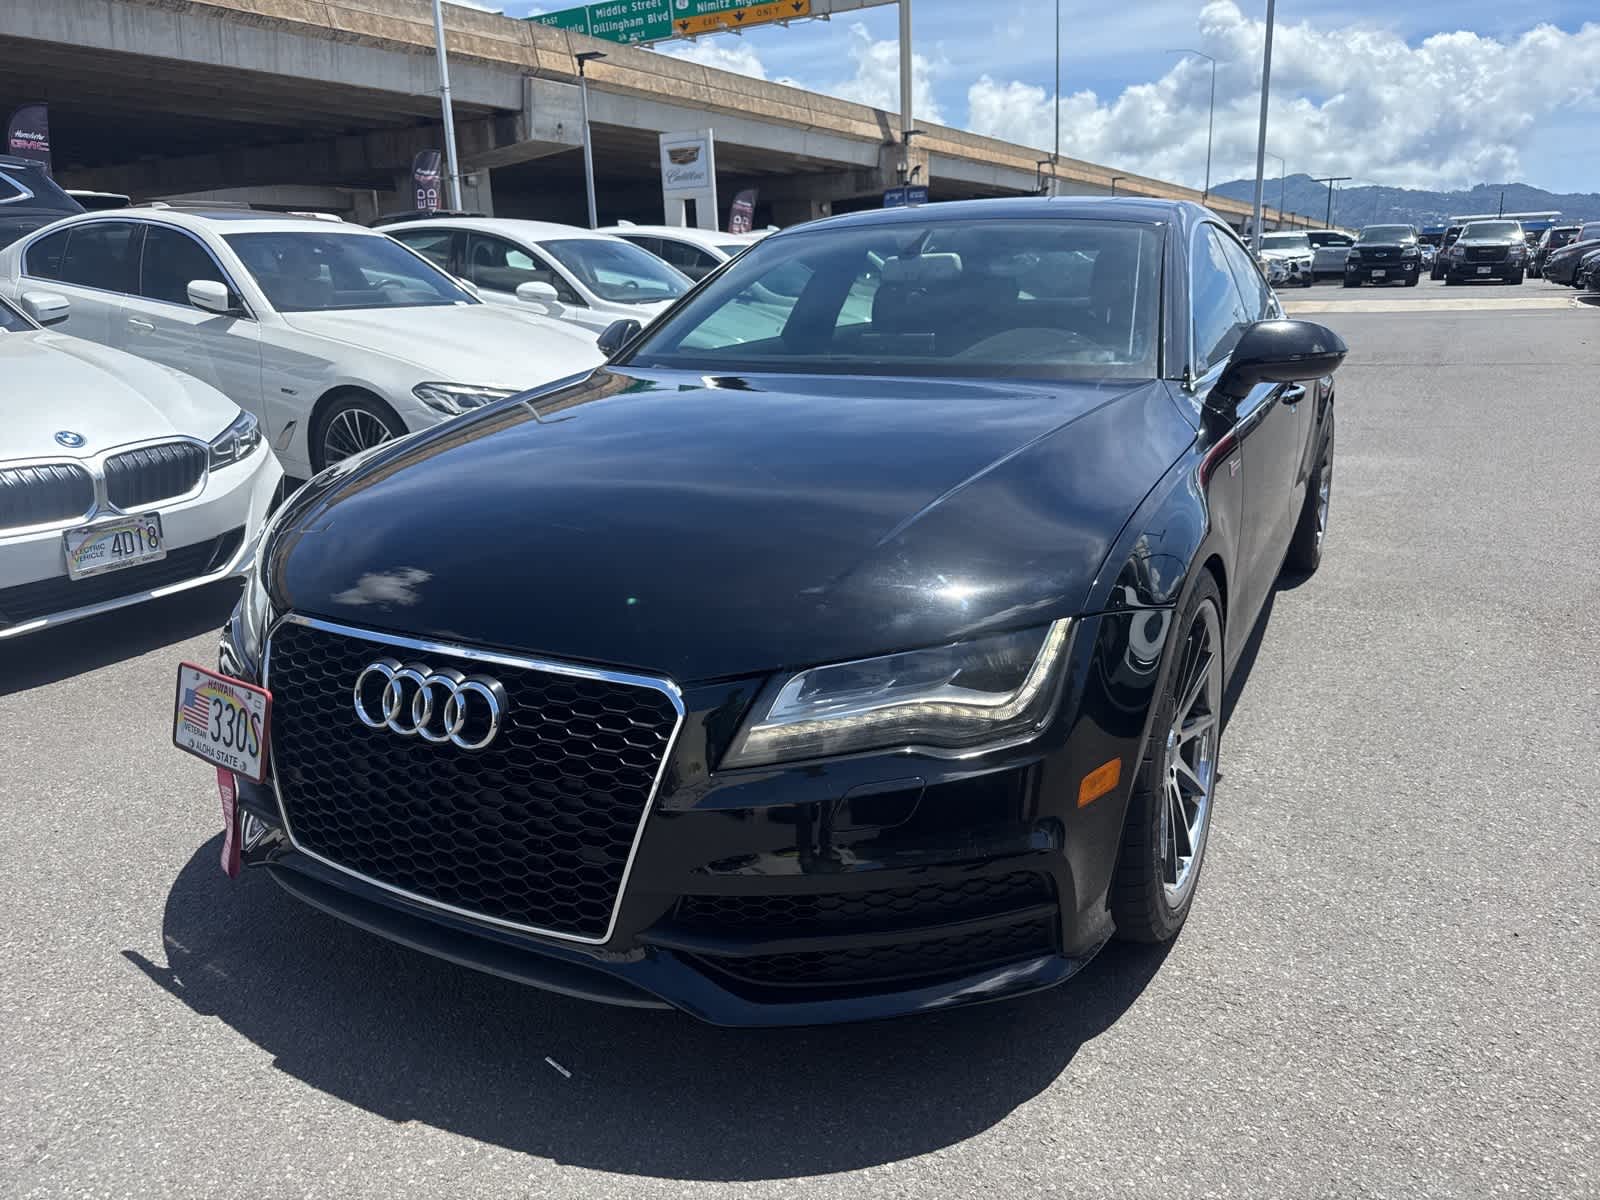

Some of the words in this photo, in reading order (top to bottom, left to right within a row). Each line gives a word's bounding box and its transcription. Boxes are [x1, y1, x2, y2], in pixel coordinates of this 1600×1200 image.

[595, 5, 627, 19] Middle
[631, 0, 662, 12] Street
[697, 0, 731, 13] Nimitz
[593, 16, 644, 34] Dillingham
[648, 11, 669, 24] Blvd
[71, 543, 105, 557] ELECTRIC
[111, 525, 159, 557] 4D18
[75, 551, 105, 562] VEHICLE
[207, 680, 234, 697] HAWAII
[184, 722, 207, 740] VETERAN
[210, 698, 261, 758] 330S
[195, 743, 215, 757] ALOHA
[215, 751, 239, 768] STATE
